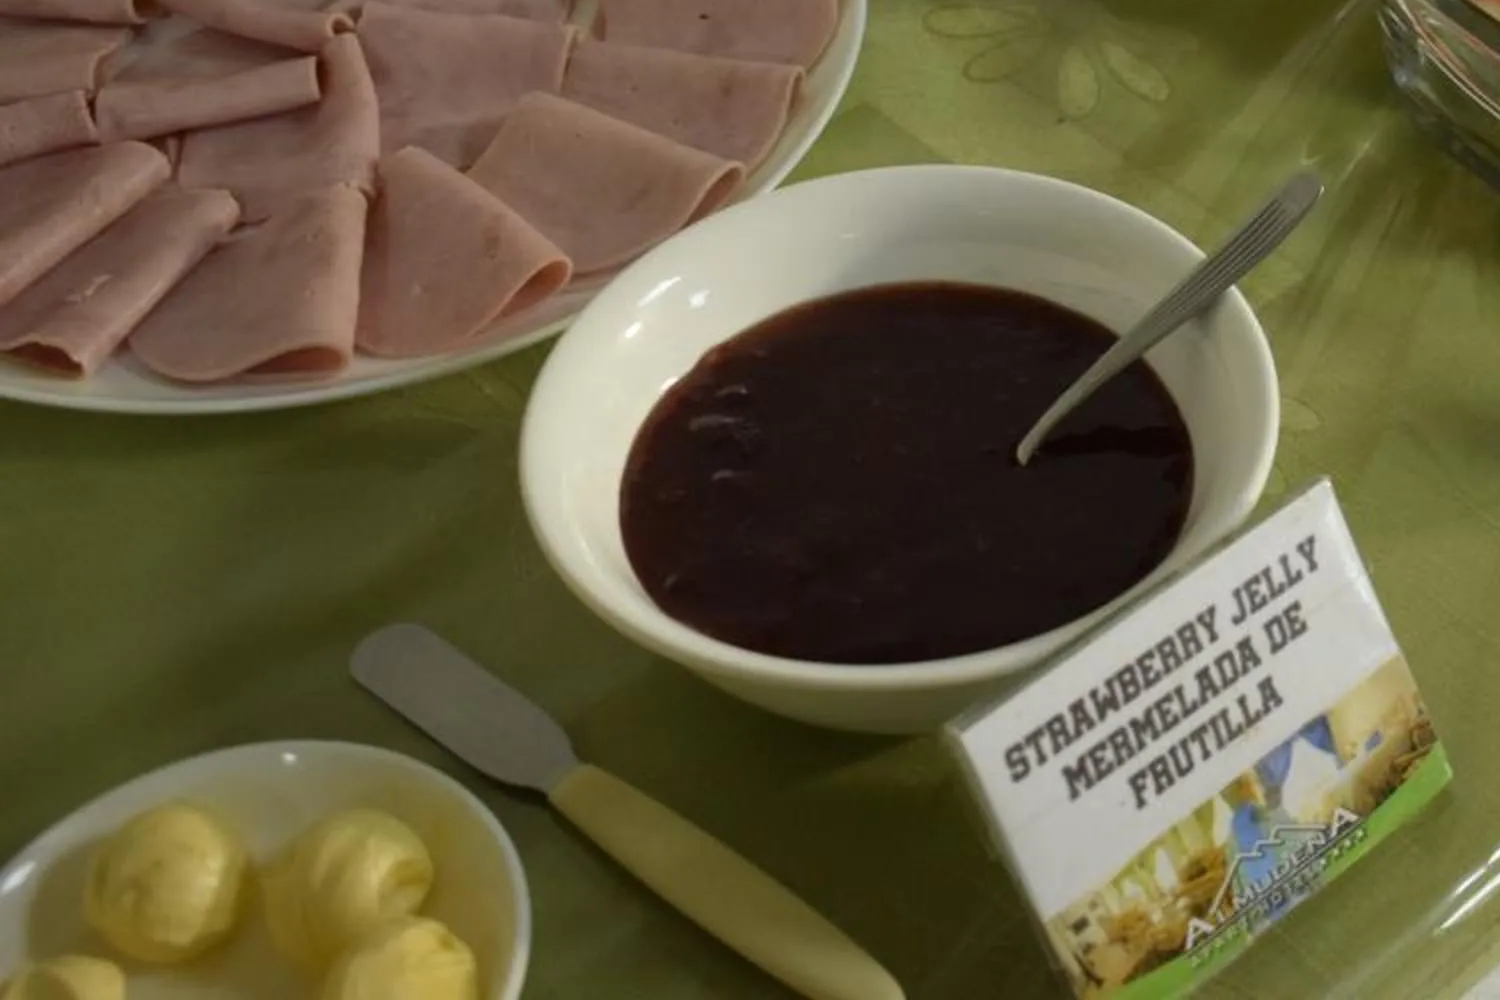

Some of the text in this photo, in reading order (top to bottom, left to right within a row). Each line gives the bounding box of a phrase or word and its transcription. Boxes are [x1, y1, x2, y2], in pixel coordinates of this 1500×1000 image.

[1004, 534, 1320, 784] STRAWBERRY JELLY
[1061, 600, 1309, 802] MERMELADA DE
[1127, 674, 1285, 811] FRUTILLA
